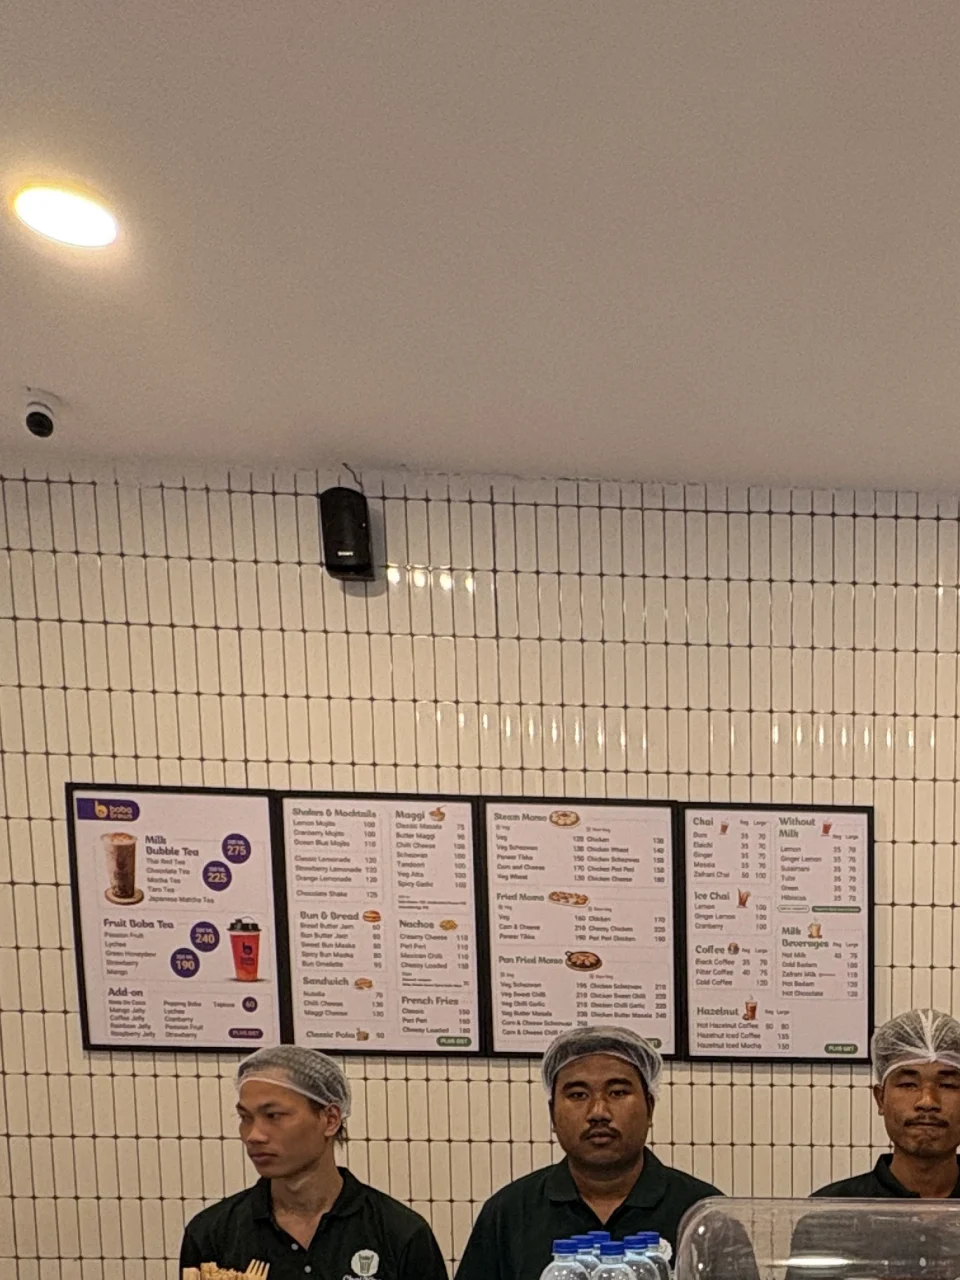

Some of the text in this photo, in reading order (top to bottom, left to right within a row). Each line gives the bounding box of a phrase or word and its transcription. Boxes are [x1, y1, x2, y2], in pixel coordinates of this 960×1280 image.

[110, 805, 132, 814] boba
[395, 810, 425, 821] Maggi
[522, 813, 547, 821] Momo
[693, 817, 714, 825] Chai
[779, 817, 815, 825] Without
[779, 829, 799, 837] Milk
[145, 835, 166, 844] Milk
[145, 846, 199, 856] Bubble Tea
[227, 845, 247, 855] 275
[208, 872, 227, 882] 225
[496, 892, 544, 901] Fried Momo
[694, 891, 730, 900] Ice Chai
[300, 911, 318, 919] Bun
[331, 912, 359, 920] Bread
[103, 919, 174, 929] Fruit Boba Tea
[399, 920, 434, 928] Nachos
[195, 934, 215, 943] 240
[782, 939, 829, 948] Beverages
[695, 945, 725, 954] Coffee
[498, 955, 563, 964] Pan Fried Momo
[176, 960, 195, 970] 190
[303, 977, 349, 985] Sandwich
[108, 988, 143, 996] Add-on
[402, 996, 458, 1005] French Fries
[697, 1007, 739, 1015] Hazelnut
